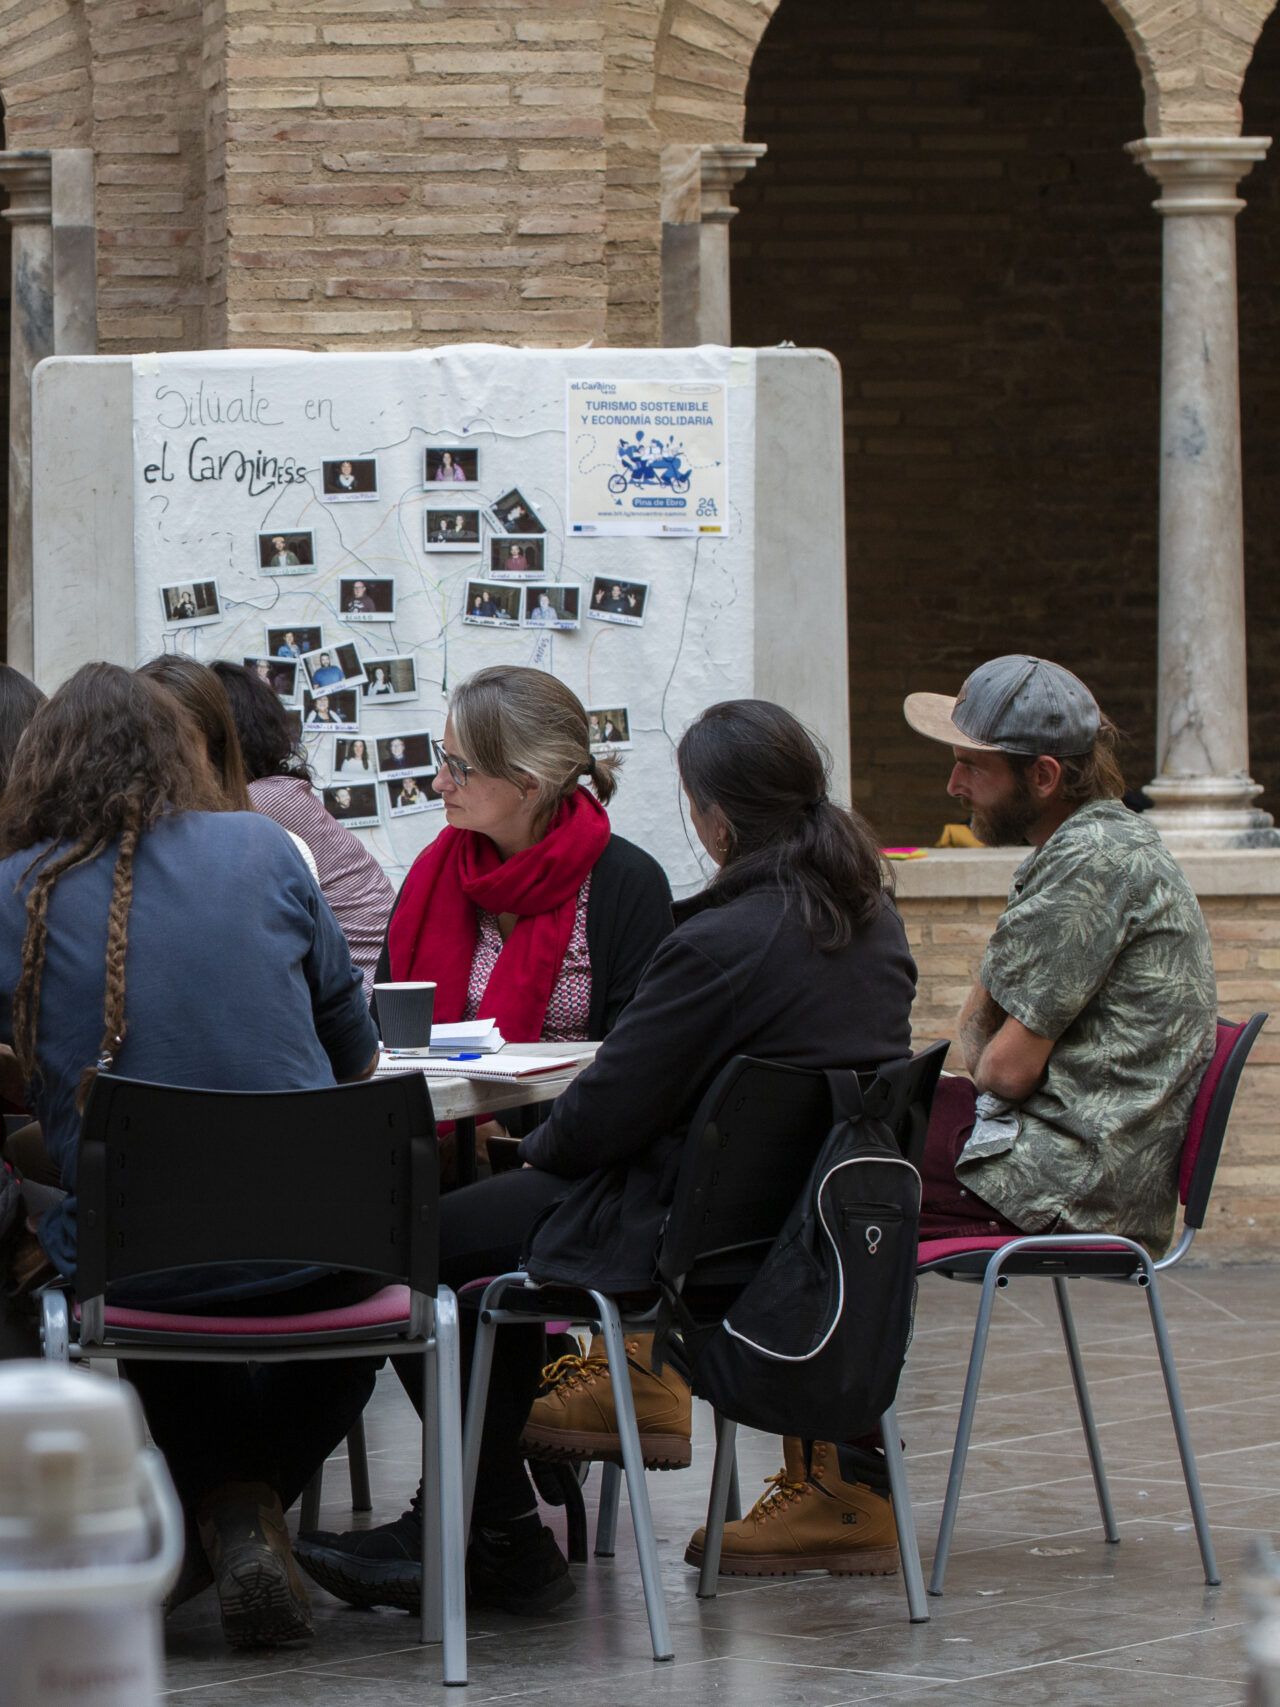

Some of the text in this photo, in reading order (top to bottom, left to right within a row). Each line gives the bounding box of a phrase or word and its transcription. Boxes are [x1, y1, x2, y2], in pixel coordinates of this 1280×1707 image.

[585, 401, 709, 412] TURISMO SOSTENIBLE
[305, 399, 340, 431] en
[581, 414, 714, 426] Y ECONOMÍA SOLIDARIA
[634, 498, 685, 507] Pina de Ebro
[698, 497, 715, 508] 24
[695, 506, 718, 517] oct
